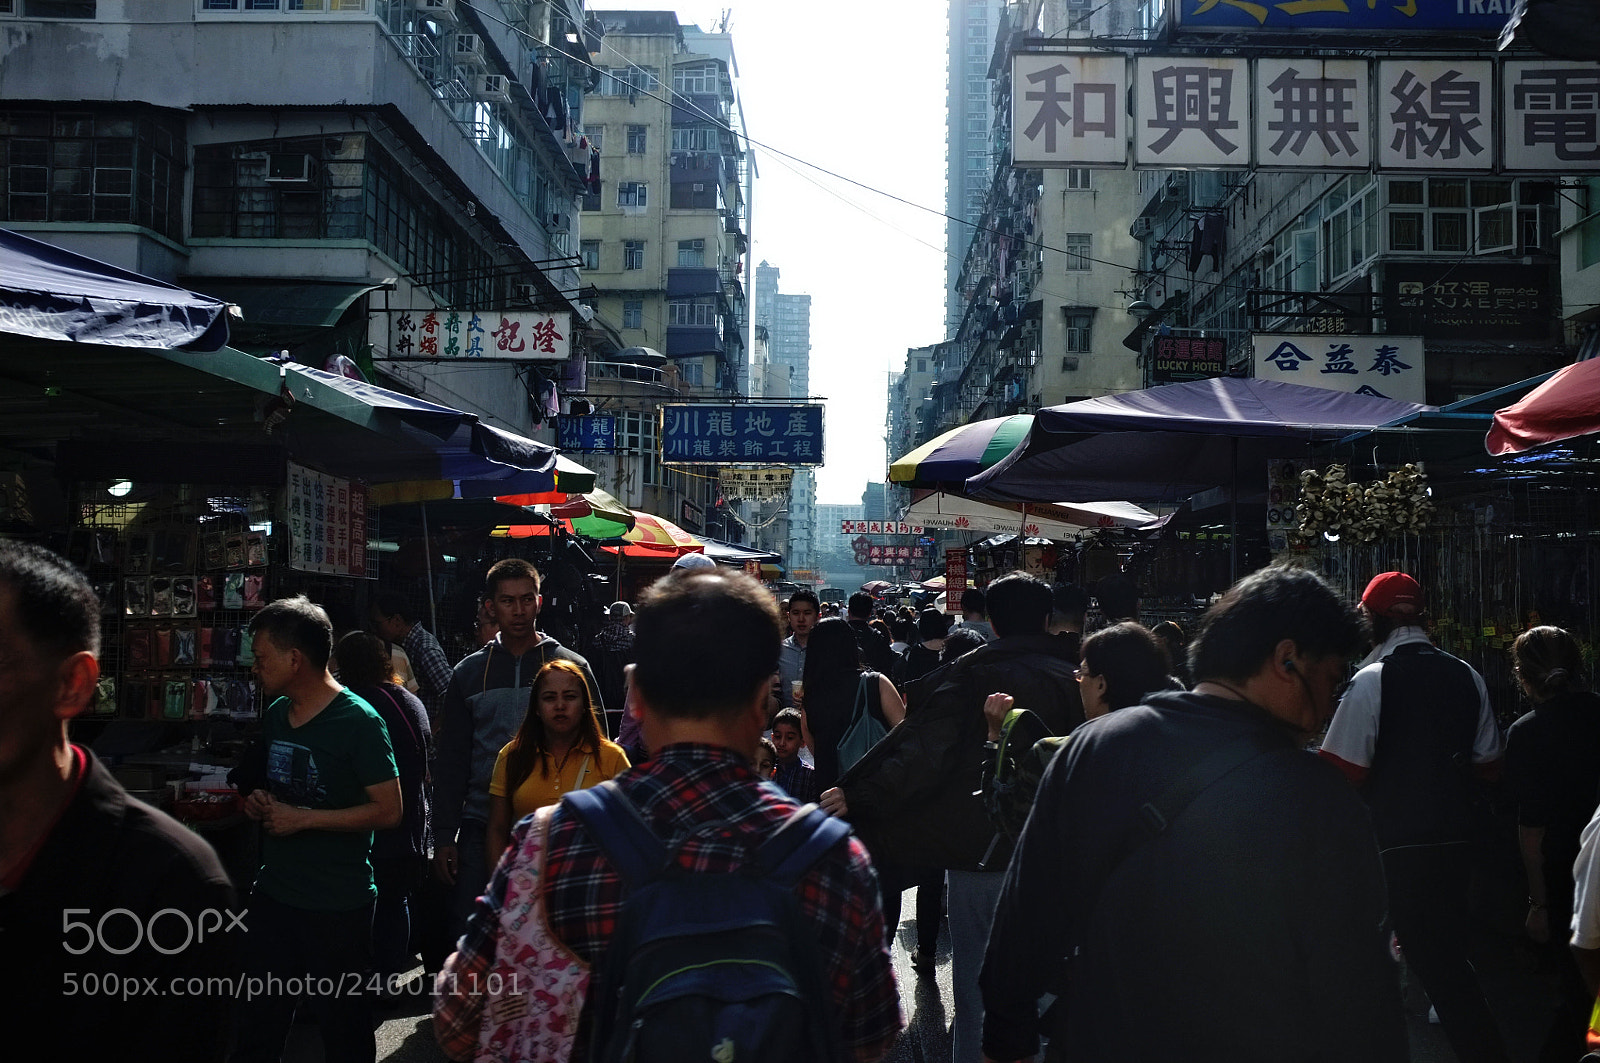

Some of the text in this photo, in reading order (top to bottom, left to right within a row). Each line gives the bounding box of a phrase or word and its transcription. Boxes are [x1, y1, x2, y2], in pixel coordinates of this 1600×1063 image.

[1023, 64, 1600, 161] 和興無線電
[419, 312, 440, 356] 香燭
[444, 312, 462, 356] 精品
[465, 314, 485, 357] 文具
[1157, 360, 1223, 373] LUCKY HOTEL
[562, 418, 611, 436] 川龍
[667, 411, 819, 437] 川龍地產
[667, 439, 813, 457] 川龍裝飾工程
[314, 480, 323, 564] 快速維修
[326, 485, 335, 565] 手提電腦
[338, 488, 347, 566] 回收手機
[351, 489, 364, 568] 超高價
